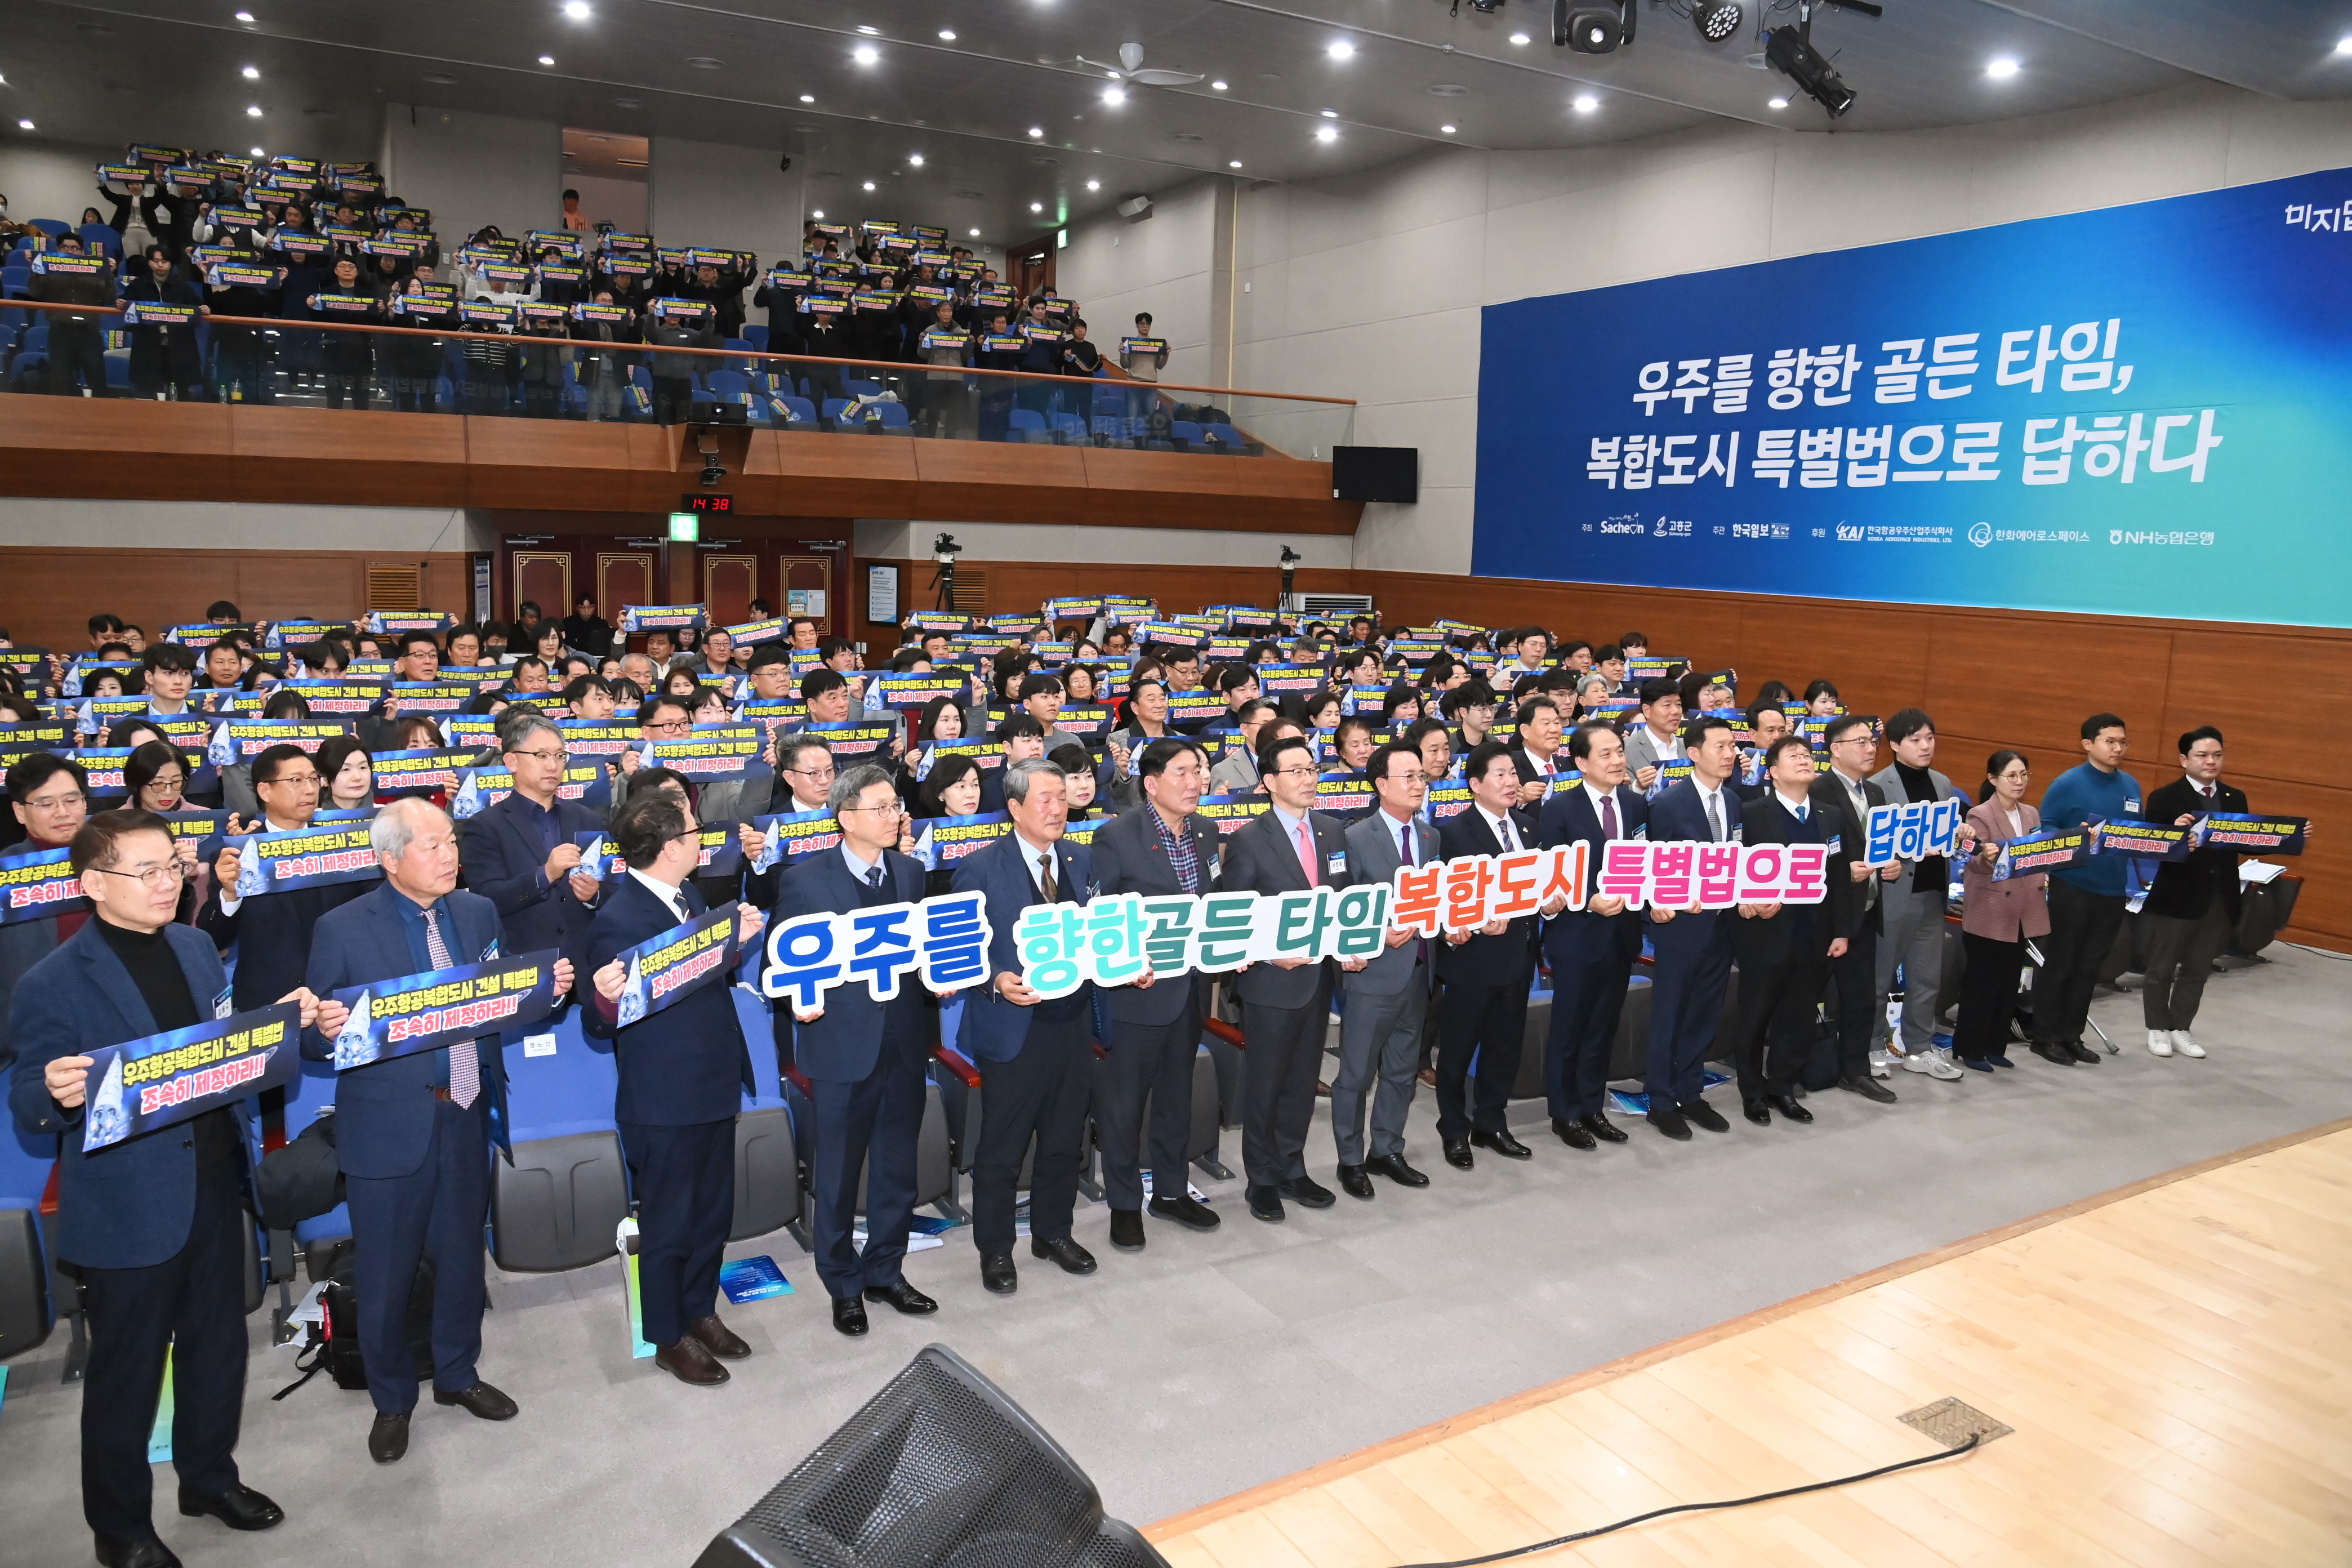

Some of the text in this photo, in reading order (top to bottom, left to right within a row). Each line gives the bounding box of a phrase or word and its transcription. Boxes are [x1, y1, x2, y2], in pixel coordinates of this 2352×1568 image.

[2285, 200, 2352, 233] 미지
[1633, 318, 2133, 416] 우주를 향한 골든 타임,
[1587, 409, 2223, 489] 복합도시 특별법으로 답하다
[693, 498, 729, 510] 14 38
[1582, 523, 1593, 532] 주최
[1601, 520, 1644, 534] Sacheon
[1669, 521, 1692, 532] 고흥군
[1712, 525, 1726, 535] 주관
[1732, 523, 1769, 538] 한국일보
[1811, 528, 1826, 538] 후원
[1836, 523, 1865, 540] KAI
[1867, 525, 1953, 536] 한국항공우주산업주식회사
[1995, 529, 2090, 542] 한화에어로스페이스
[2125, 531, 2215, 546] NH농협은행
[436, 671, 484, 680] 우주항공복합도시
[496, 670, 514, 679] 특별법
[1261, 669, 1325, 679] 우주항공복합도시 건설 특별법
[880, 679, 963, 690] 우주항공복합도시 건설 특별법
[1268, 679, 1317, 690] 조속히 제정하라!!
[343, 687, 382, 698] 건설 특별법
[435, 688, 471, 697] 건설 특별법
[888, 691, 913, 702] 조속히
[323, 700, 369, 712] 제정하라!!
[1169, 697, 1221, 707] 우주항공복합도시 건설
[1075, 711, 1107, 720] 건설 특별법
[1174, 707, 1226, 718] 조속히 제정하라!!
[230, 725, 344, 738] 우주항공복합도시 건설 특별법
[1062, 721, 1098, 732] 제정하라!!
[854, 728, 890, 740] 건설 특별법
[655, 741, 759, 758] 우주항공복합도시 건설 특별법
[837, 741, 877, 754] 제정하라!!
[696, 757, 745, 772] 제정하라!!
[1343, 781, 1360, 792] 건설
[1325, 795, 1370, 809] 제정하라!!
[1232, 803, 1248, 817] 건설
[181, 820, 215, 834] 특별법
[933, 822, 998, 843] 우주항공복합도시
[2102, 825, 2184, 840] 우주항공복합도시 건설 특별법
[2207, 820, 2297, 835] 우주항공복합도시 건설 특별법
[259, 830, 370, 857] 우주항공복합도시 건설
[789, 835, 824, 854] 조속히
[2010, 835, 2082, 856] 우주항공복합도시 건설 특별법
[2105, 836, 2170, 852] 조속히 제정하라!!
[2211, 831, 2282, 846] 조속히 제정하라!!
[2015, 849, 2074, 870] 조속히 제정하라!!
[275, 856, 321, 879] 조속히
[10, 880, 64, 906] 조속히
[772, 801, 1958, 1008] 우주를 향한 골든 타임 복합도시 특별법으로 답하다
[640, 918, 732, 975] 우주항공복합도시 건설 특별법
[652, 947, 723, 999] 조속히 제정하라!!
[372, 966, 538, 1017] 우주항공복합도시 건설 특별법
[389, 996, 518, 1042] 조속히 제정하라!!
[124, 1021, 285, 1084] 우주항공복합도시 건설 특별법
[142, 1054, 266, 1114] 조속히 제정하라!!
